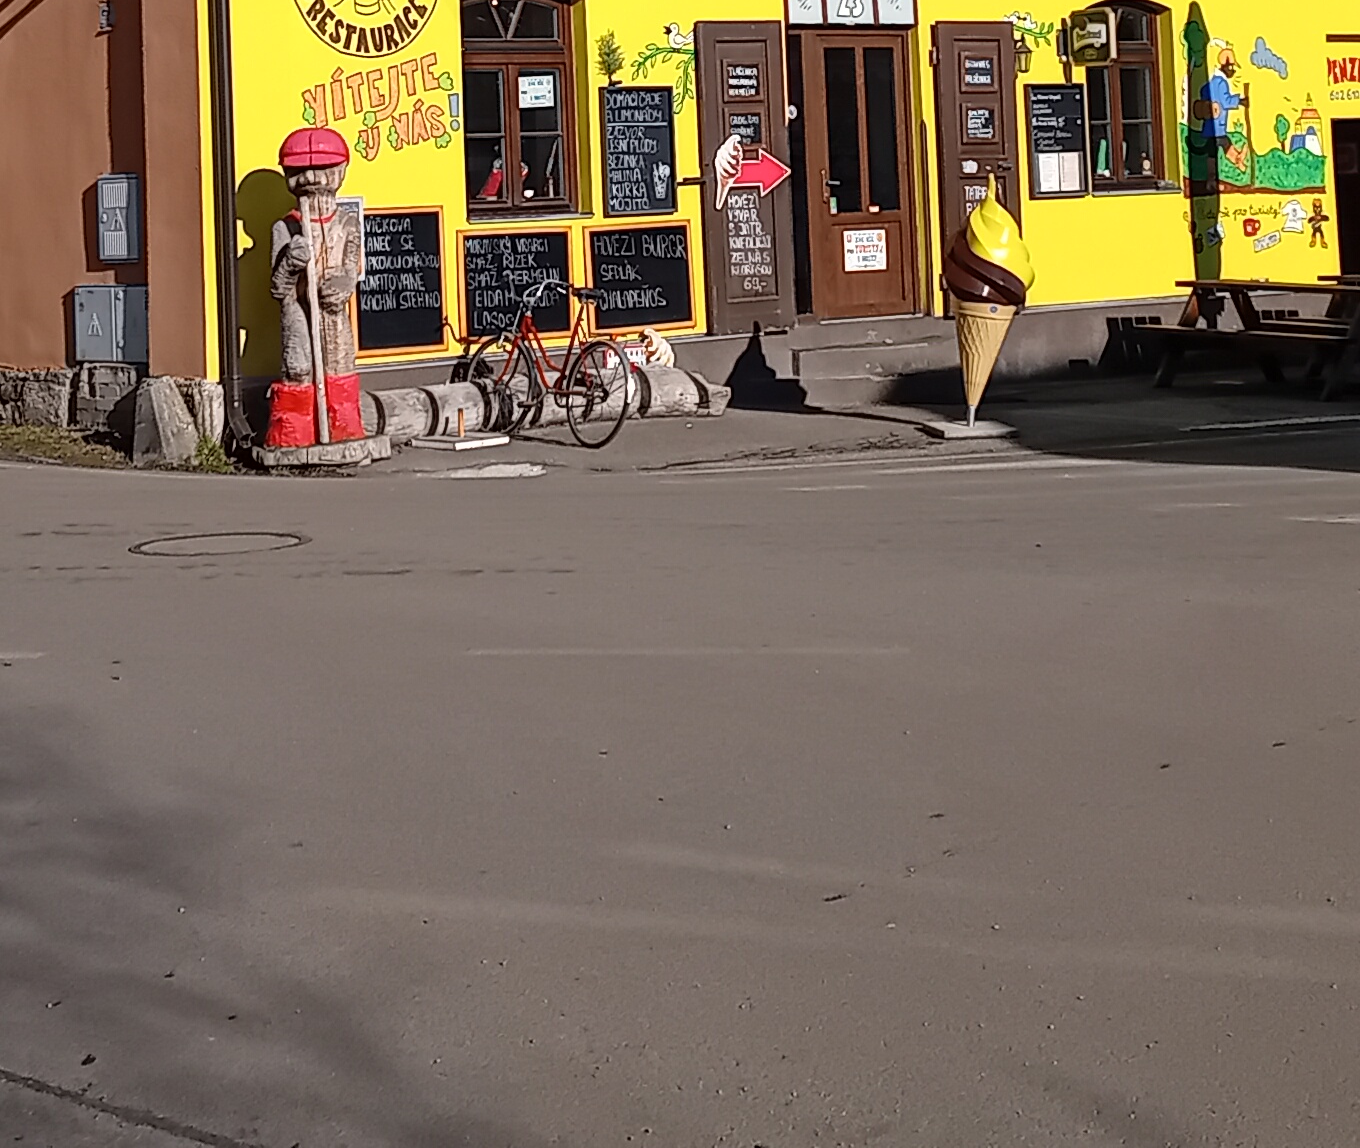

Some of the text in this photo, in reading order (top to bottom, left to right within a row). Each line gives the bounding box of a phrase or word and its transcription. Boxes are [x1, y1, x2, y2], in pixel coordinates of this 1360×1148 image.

[302, 52, 441, 128] VÍTEJTE
[638, 91, 662, 107] ČAJE
[606, 106, 662, 123] A LIMONÁDY
[358, 126, 380, 161] U
[609, 182, 648, 198] KURKA
[609, 197, 650, 210] MOJITO
[728, 222, 736, 236] S
[363, 235, 392, 252] ANEC
[399, 291, 441, 310] STEHNO
